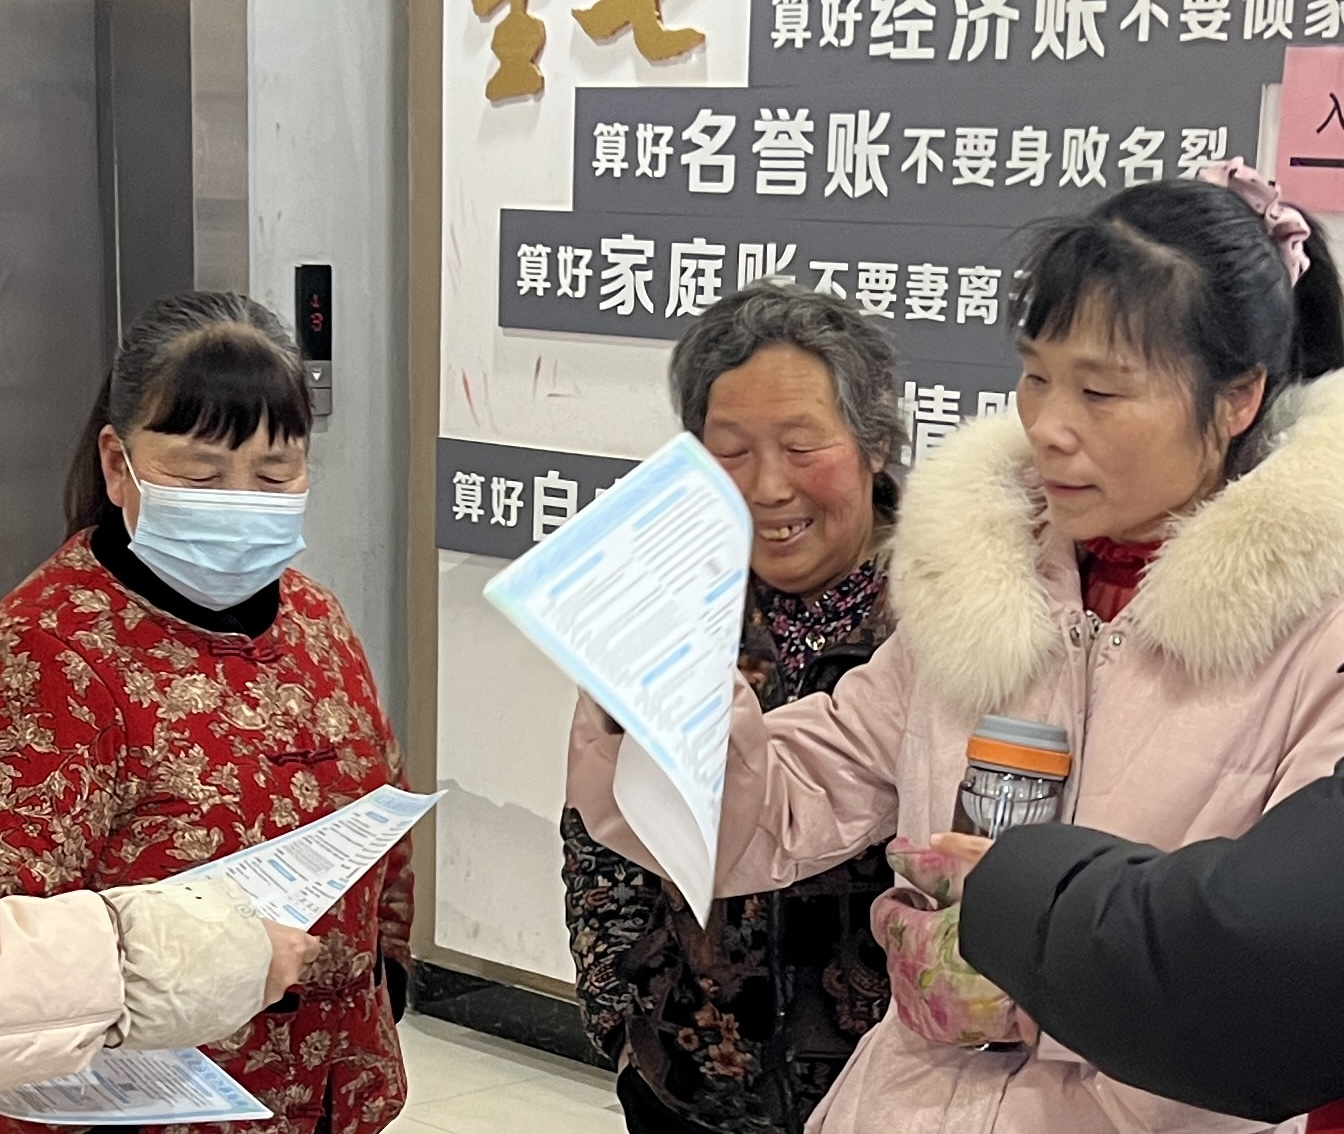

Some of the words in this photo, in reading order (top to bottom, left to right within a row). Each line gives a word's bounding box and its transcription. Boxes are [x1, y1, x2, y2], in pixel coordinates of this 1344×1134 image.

[591, 108, 1229, 199] 算好名誉账不要身败名裂
